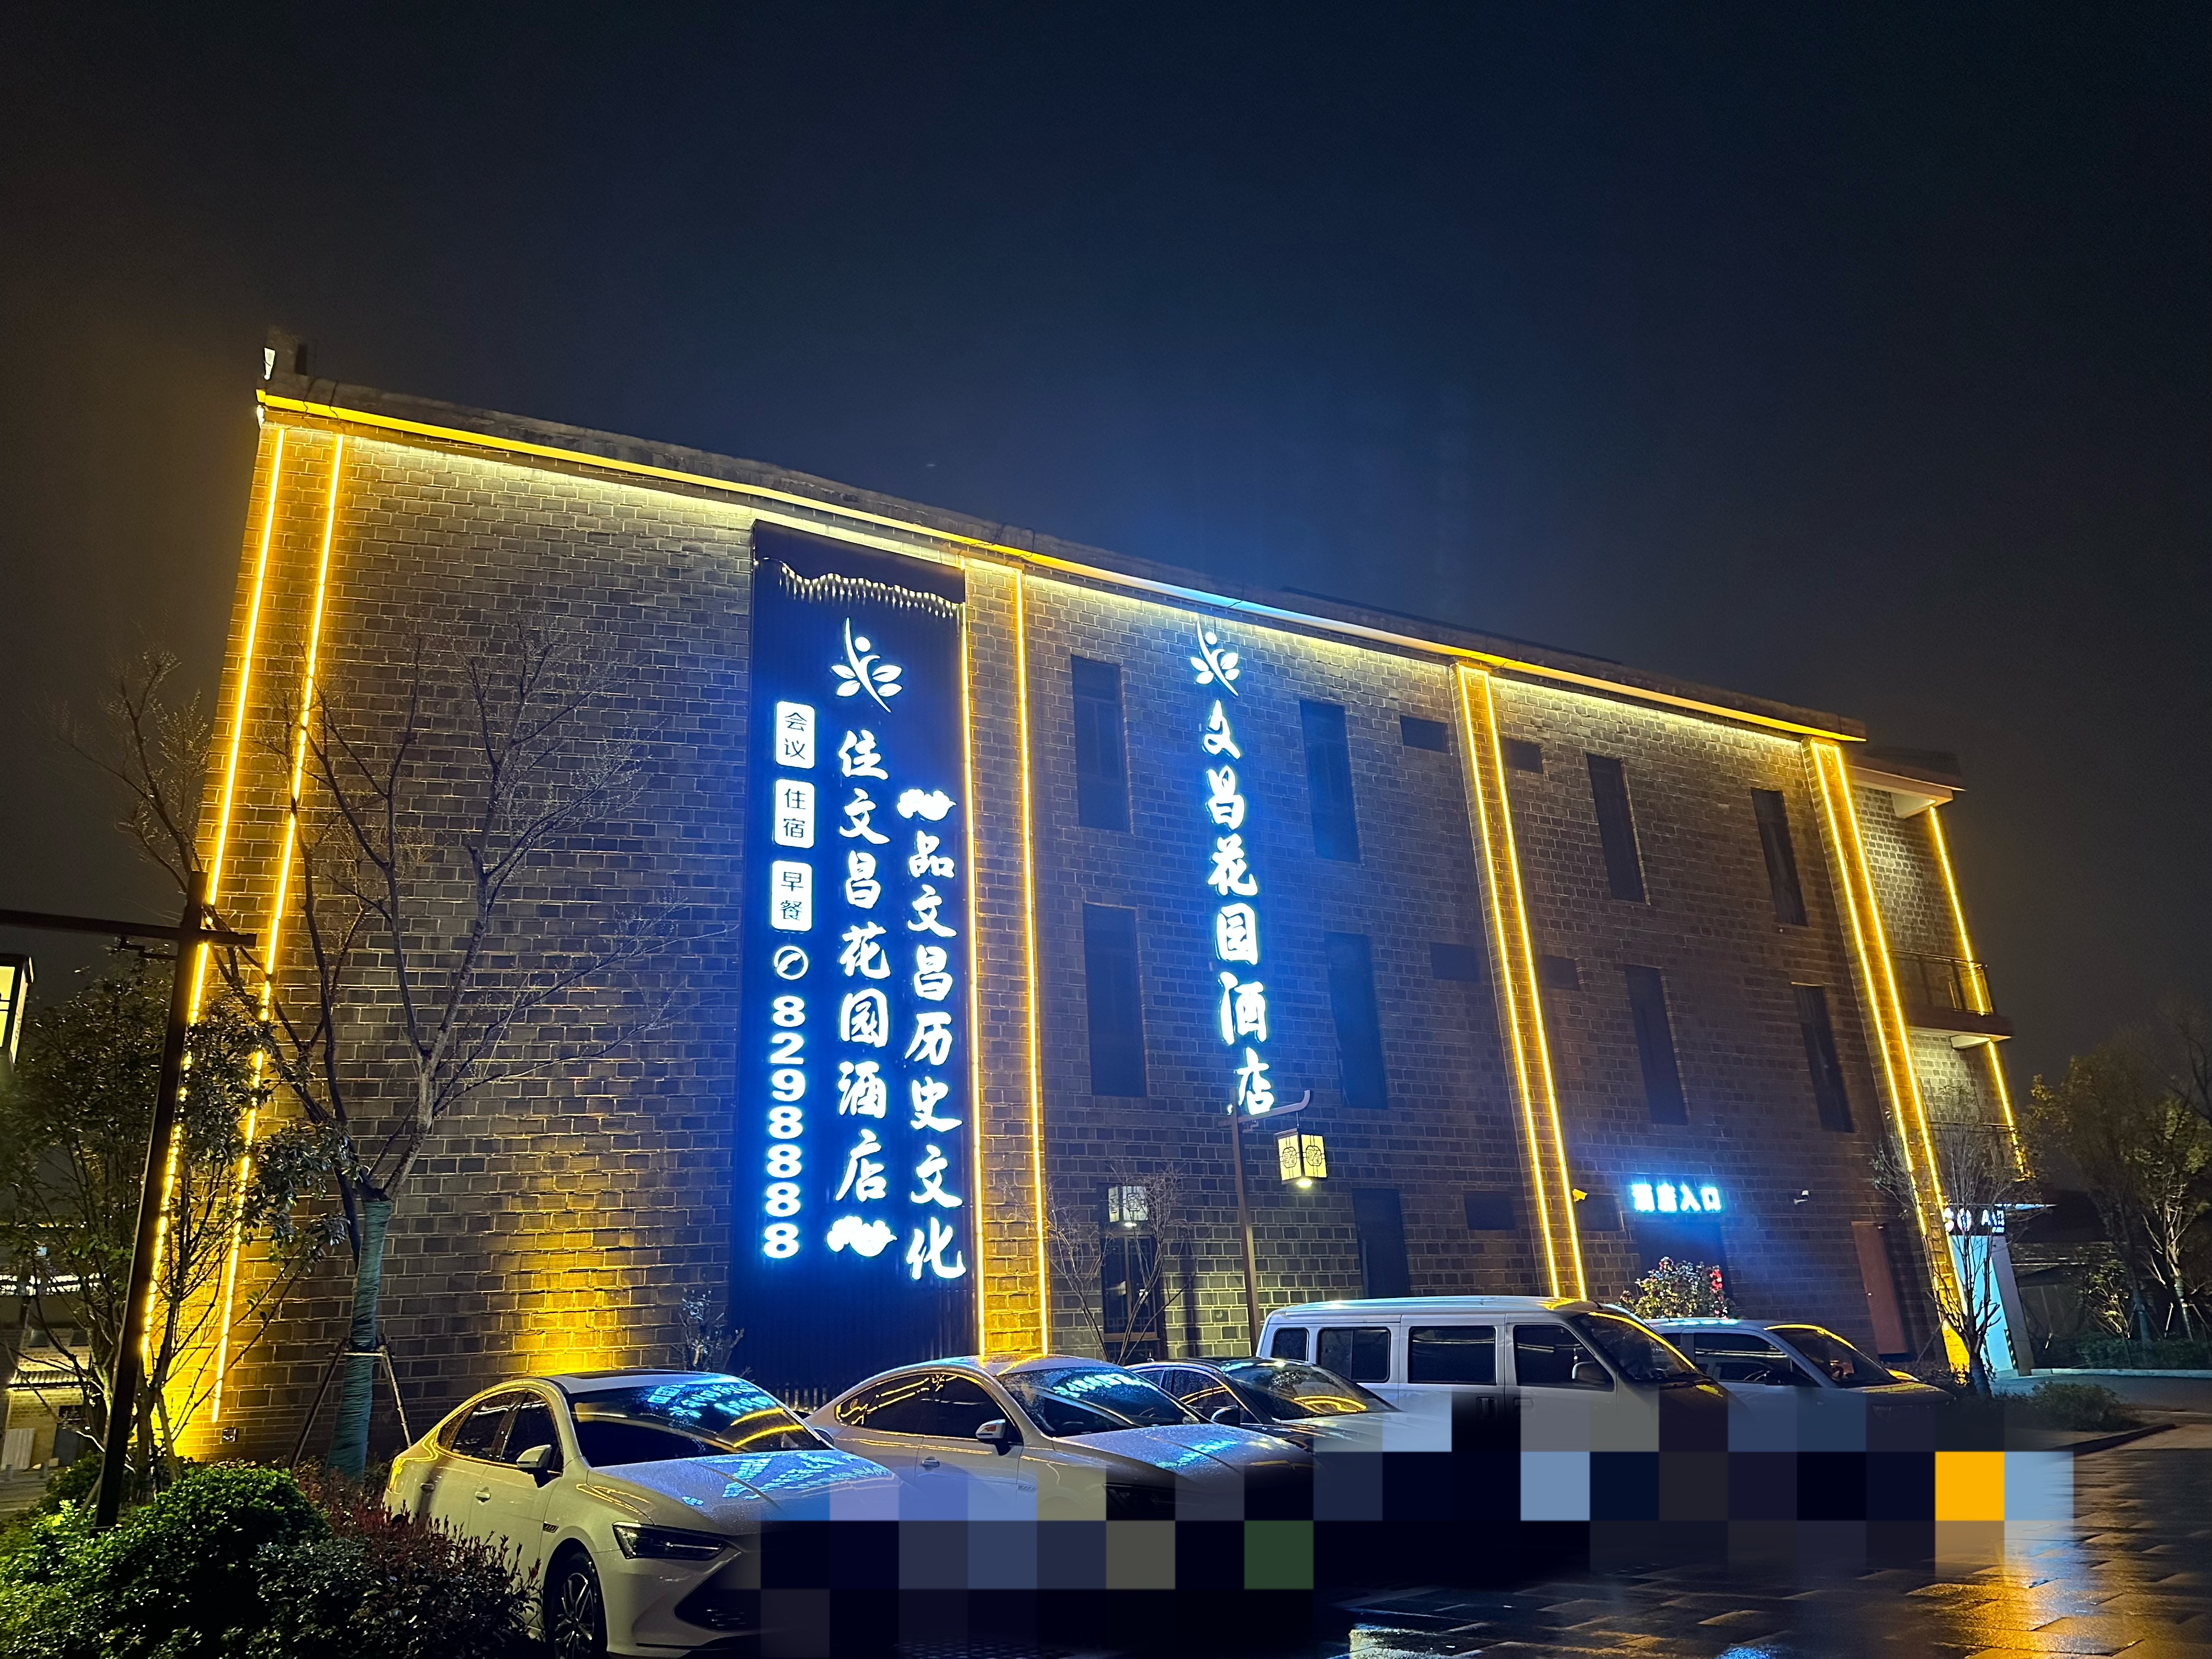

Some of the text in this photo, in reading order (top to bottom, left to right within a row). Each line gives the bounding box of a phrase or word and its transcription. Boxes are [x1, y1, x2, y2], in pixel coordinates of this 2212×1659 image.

[783, 788, 806, 838] 住宿
[784, 712, 808, 760] 会议
[779, 871, 804, 921] 早餐
[835, 729, 891, 1203] 住文昌花园酒店
[1203, 699, 1276, 1116] 文昌花园酒店
[763, 995, 806, 1260] 8298888
[904, 829, 967, 1281] 品文昌历史文化
